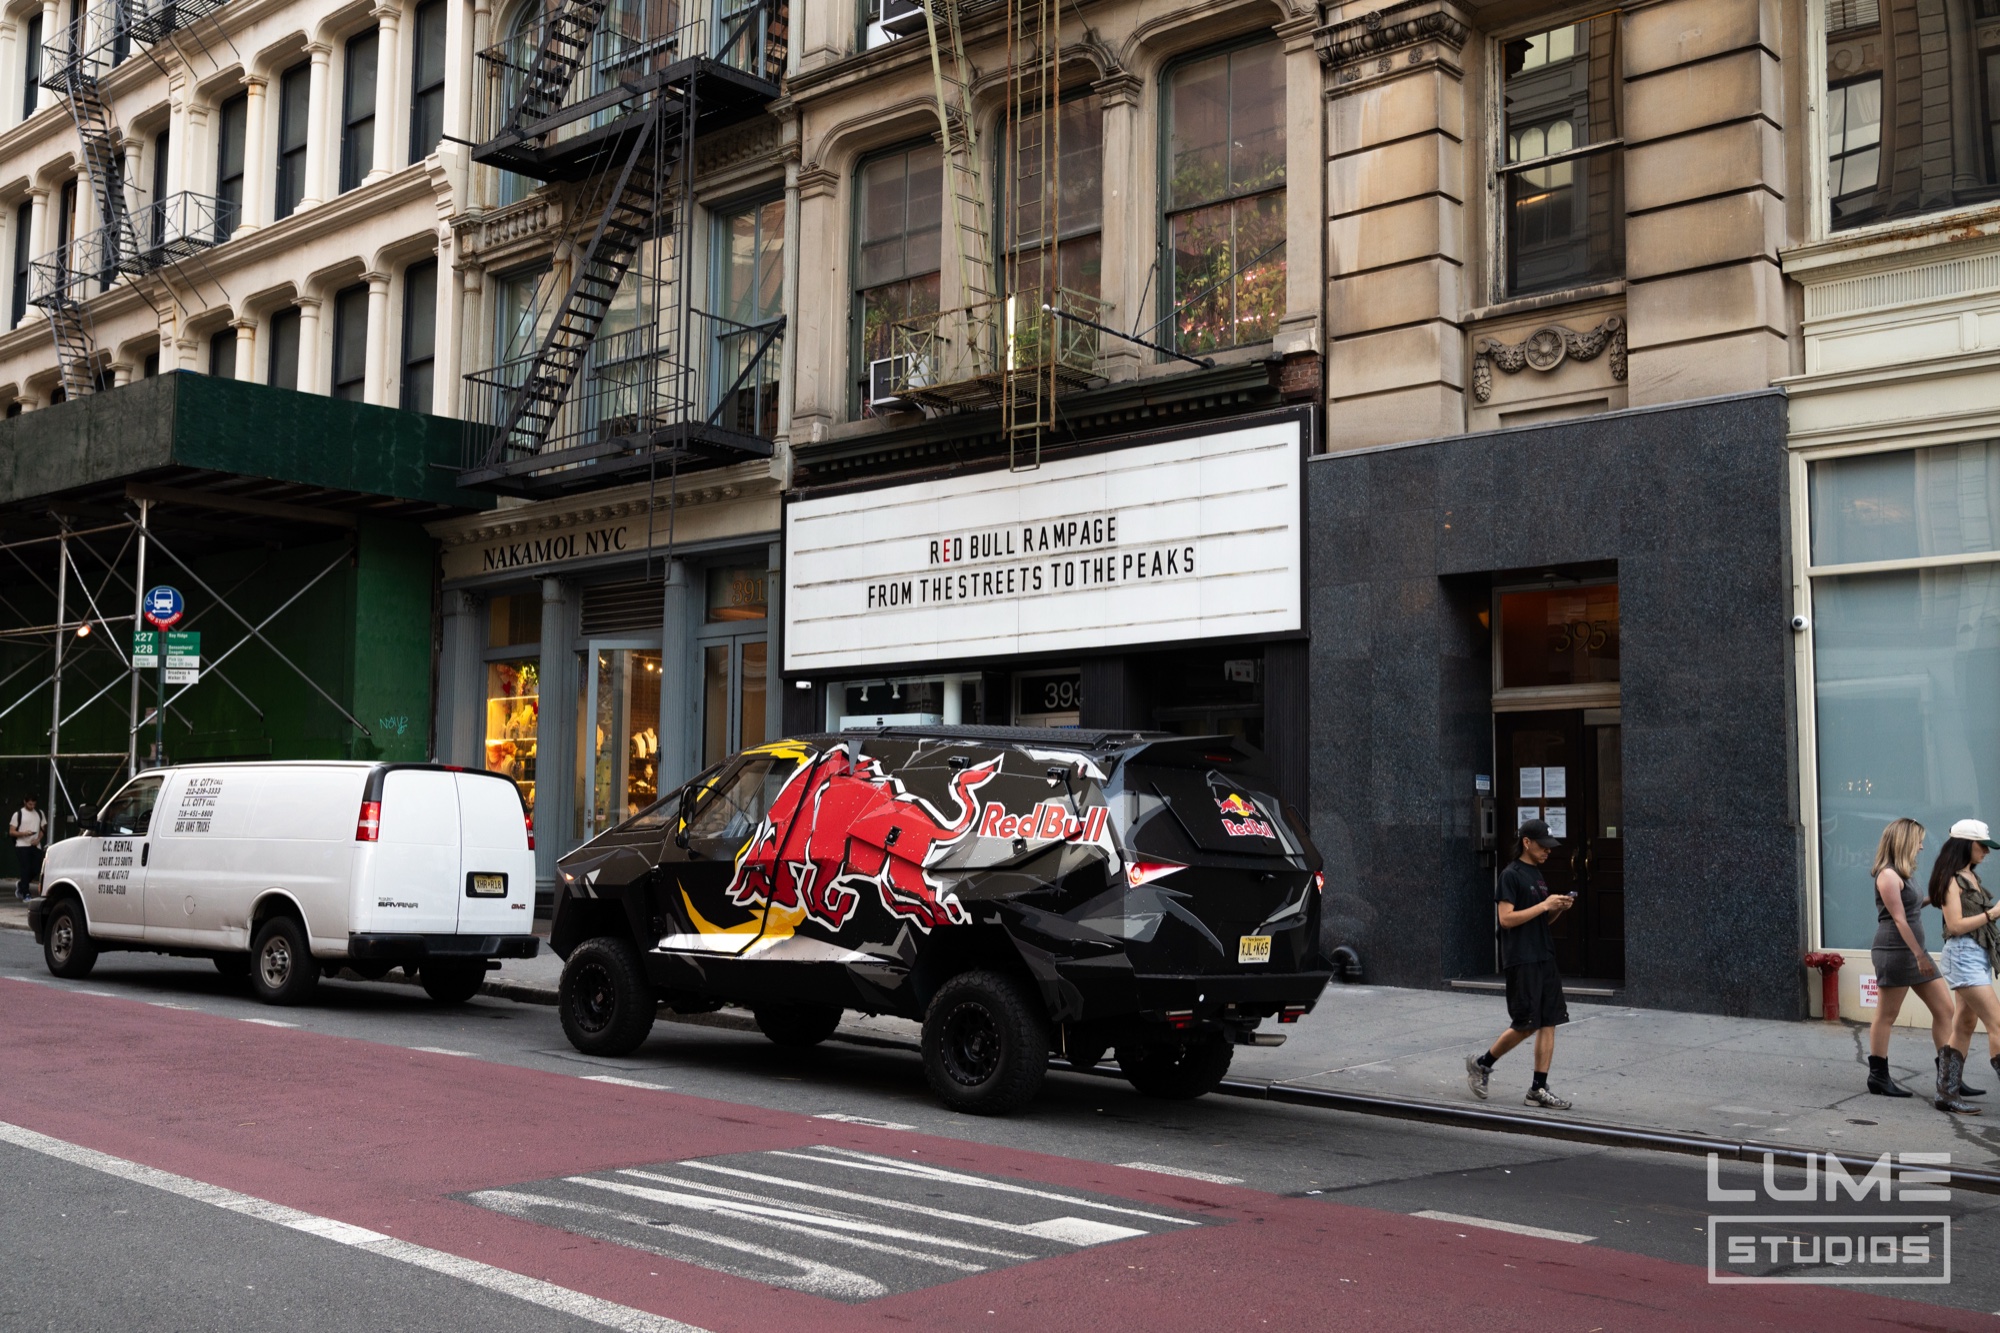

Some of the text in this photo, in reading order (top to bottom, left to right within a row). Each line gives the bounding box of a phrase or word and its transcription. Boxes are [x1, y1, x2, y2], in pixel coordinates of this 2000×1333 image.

[483, 527, 627, 571] NAKAMOL NYC
[931, 517, 1115, 564] RED BULL RAMPAGE
[732, 578, 764, 605] 391
[868, 547, 1194, 608] FROM THE STREETS TO THE PEAKS
[1555, 620, 1607, 652] 395
[200, 778, 214, 786] CITY
[193, 798, 206, 807] CITY
[978, 803, 1043, 839] Red
[113, 841, 132, 852] RENTAL
